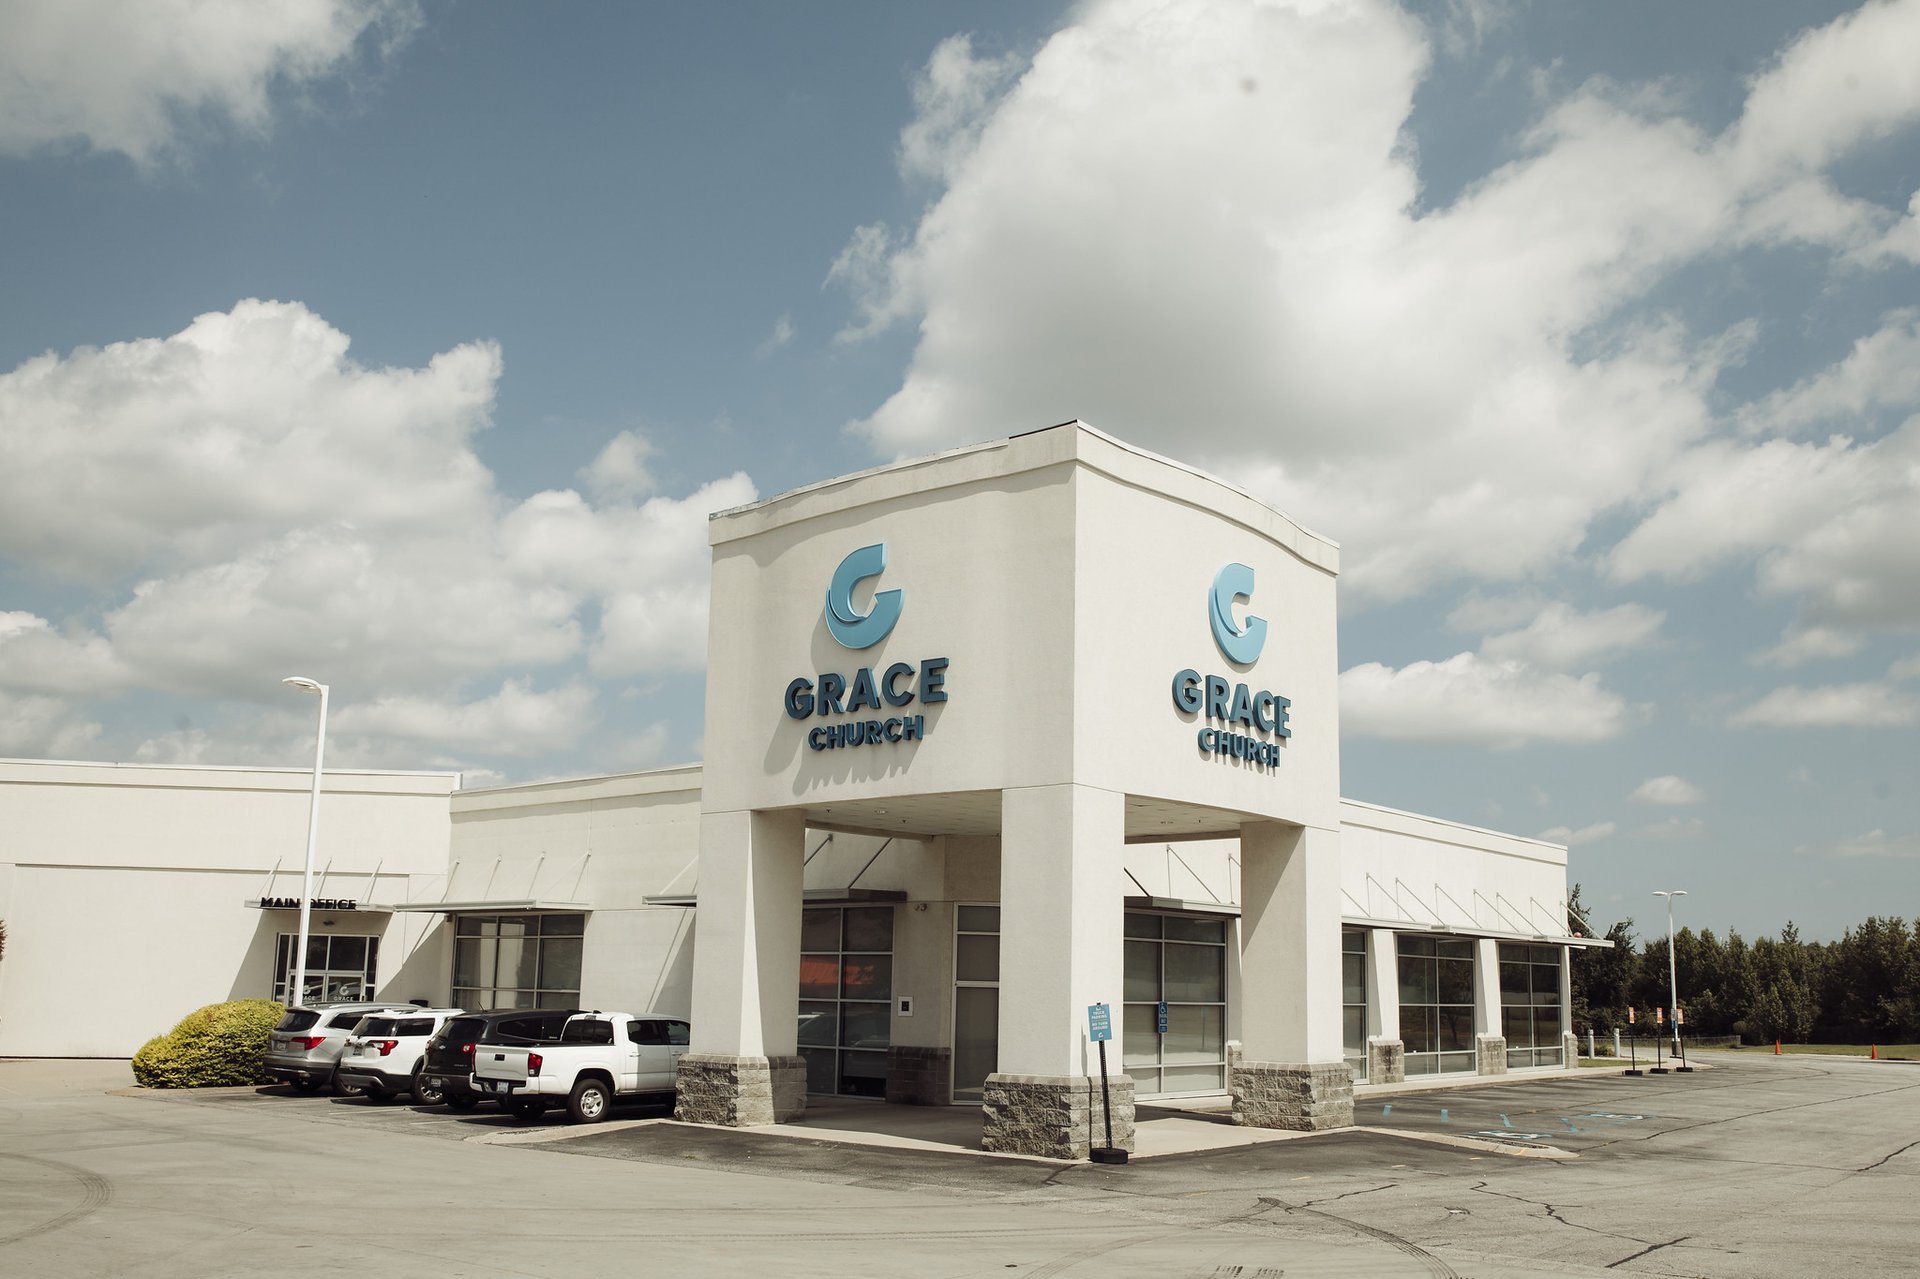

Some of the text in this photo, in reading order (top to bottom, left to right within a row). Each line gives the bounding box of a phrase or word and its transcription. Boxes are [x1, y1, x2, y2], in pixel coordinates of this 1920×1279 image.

[784, 657, 950, 720] GRACE
[1172, 668, 1292, 738] GRACE
[808, 715, 924, 751] CHURCH
[1197, 727, 1280, 767] CHURCH
[260, 897, 300, 908] MAIN
